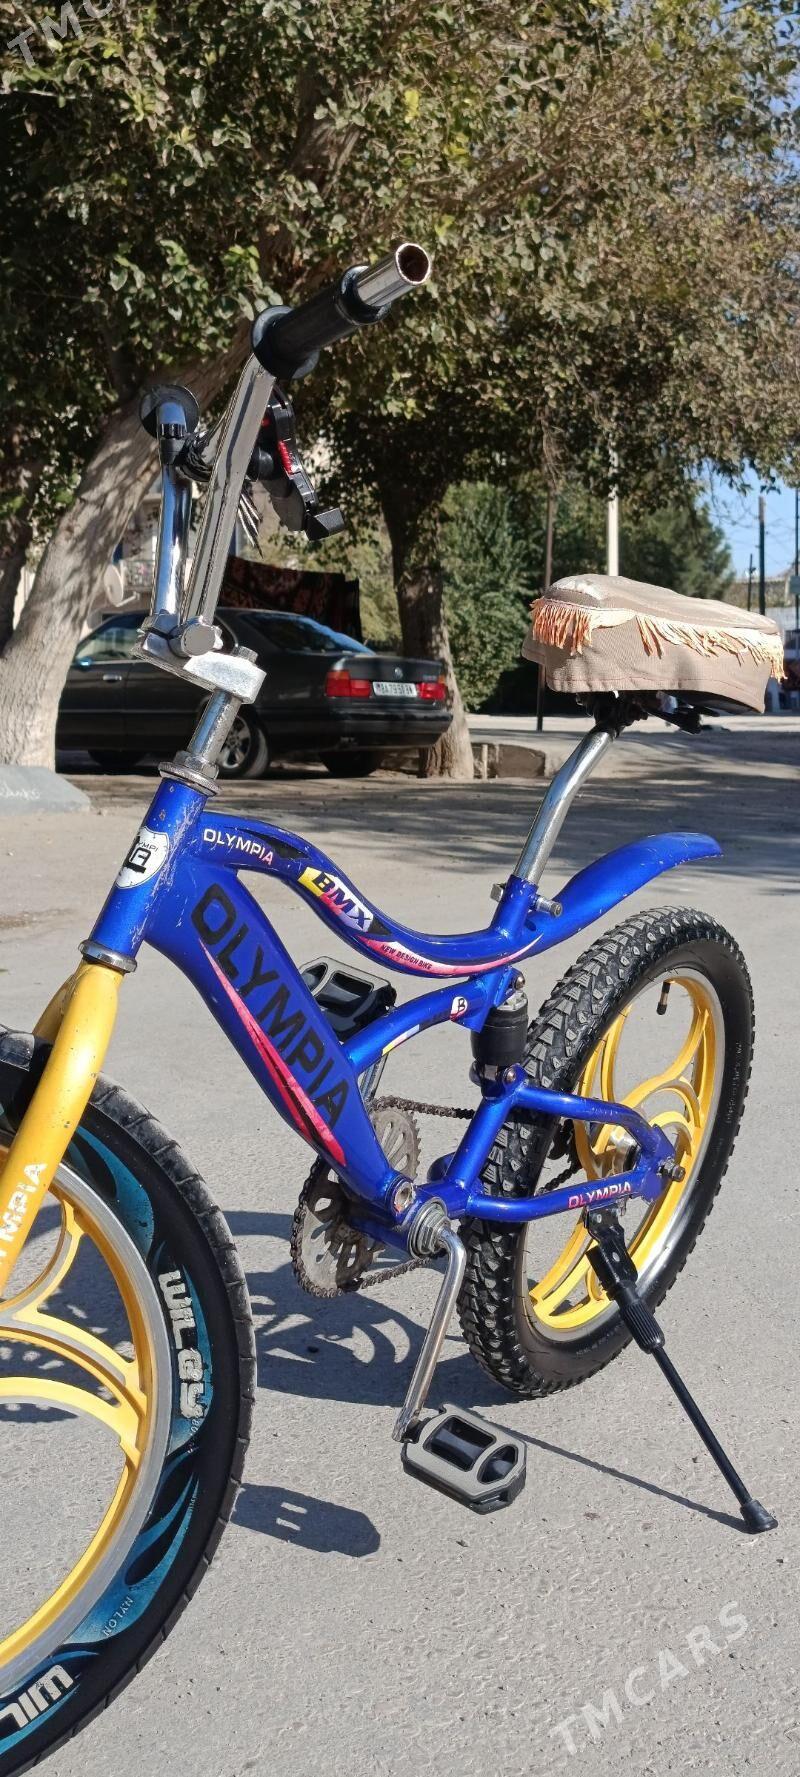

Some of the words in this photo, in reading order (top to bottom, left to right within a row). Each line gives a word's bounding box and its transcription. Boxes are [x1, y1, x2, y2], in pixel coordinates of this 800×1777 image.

[203, 828, 274, 865] OLYMPIA
[312, 871, 372, 930] BMX
[380, 944, 397, 955] NEW
[396, 950, 420, 965] DESIGN
[418, 960, 433, 970] BIKE
[191, 883, 349, 1131] OLYMPIA
[0, 1163, 48, 1257] MPIA
[568, 1181, 632, 1209] OLYMPIA
[103, 1596, 134, 1636] NYLON
